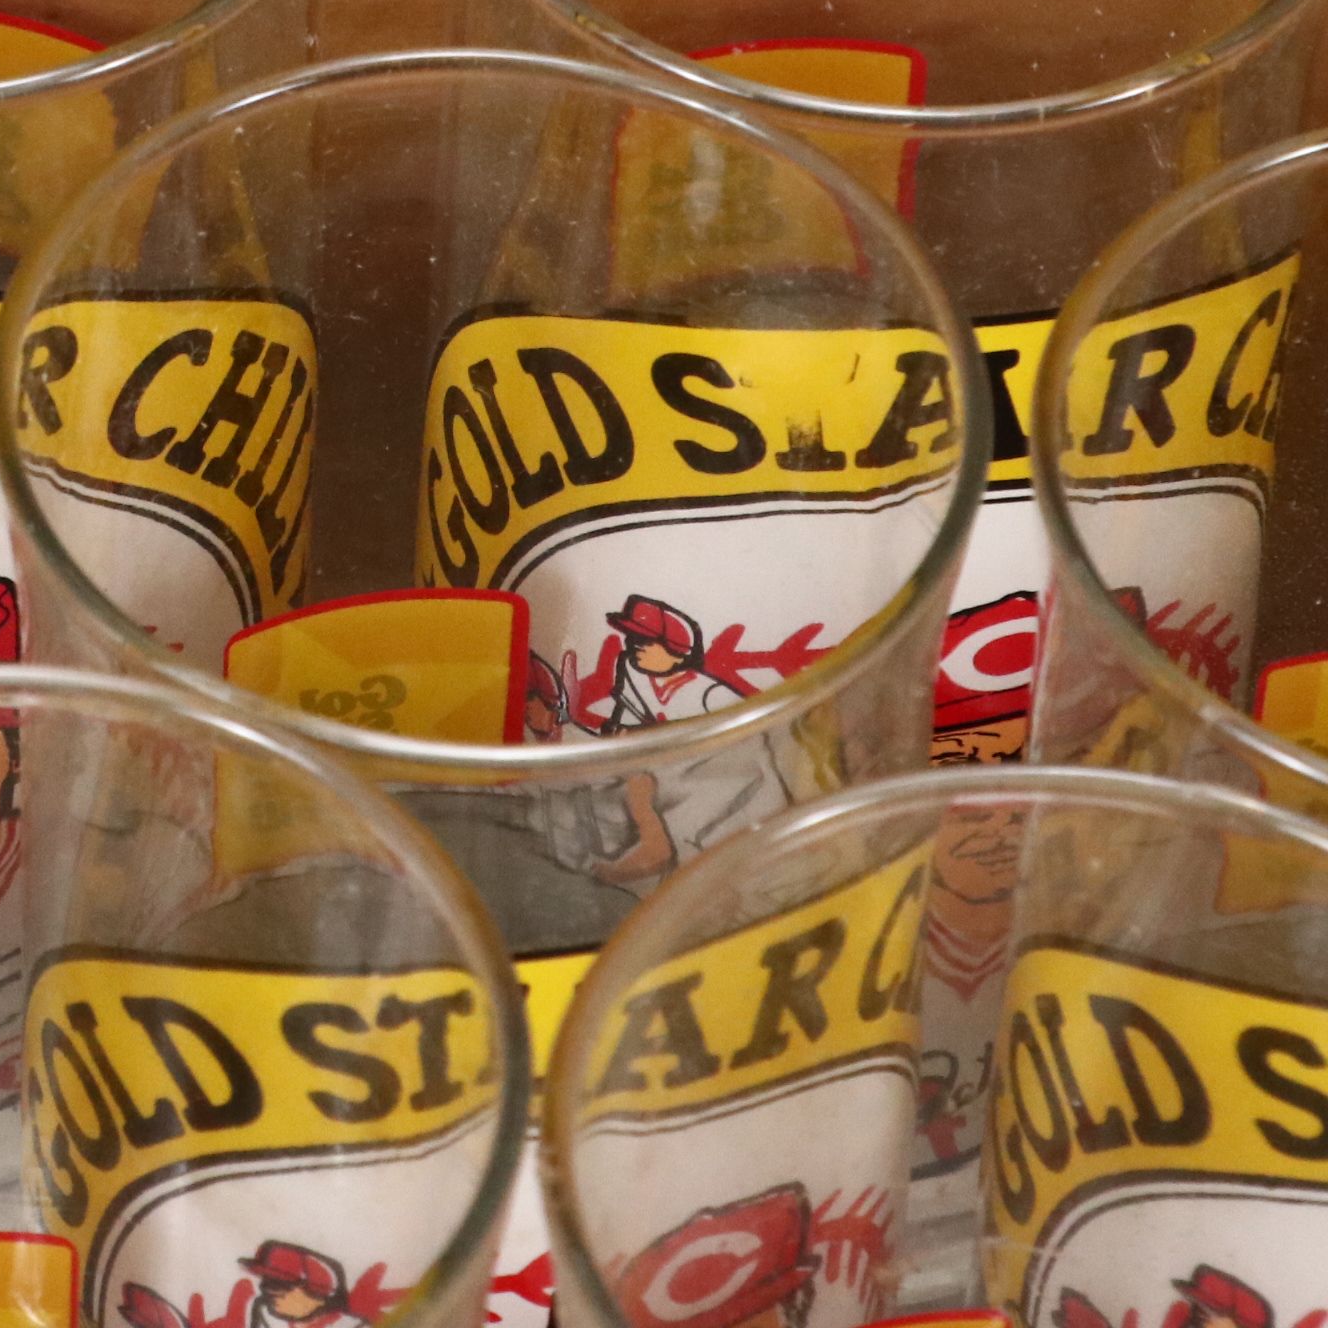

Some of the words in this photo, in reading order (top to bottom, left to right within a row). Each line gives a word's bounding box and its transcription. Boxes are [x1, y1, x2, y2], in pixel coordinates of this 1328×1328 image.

[428, 347, 635, 588] GOLD
[28, 995, 264, 1228] GOLD
[280, 918, 848, 1124] STAR
[992, 993, 1213, 1227] GOLD
